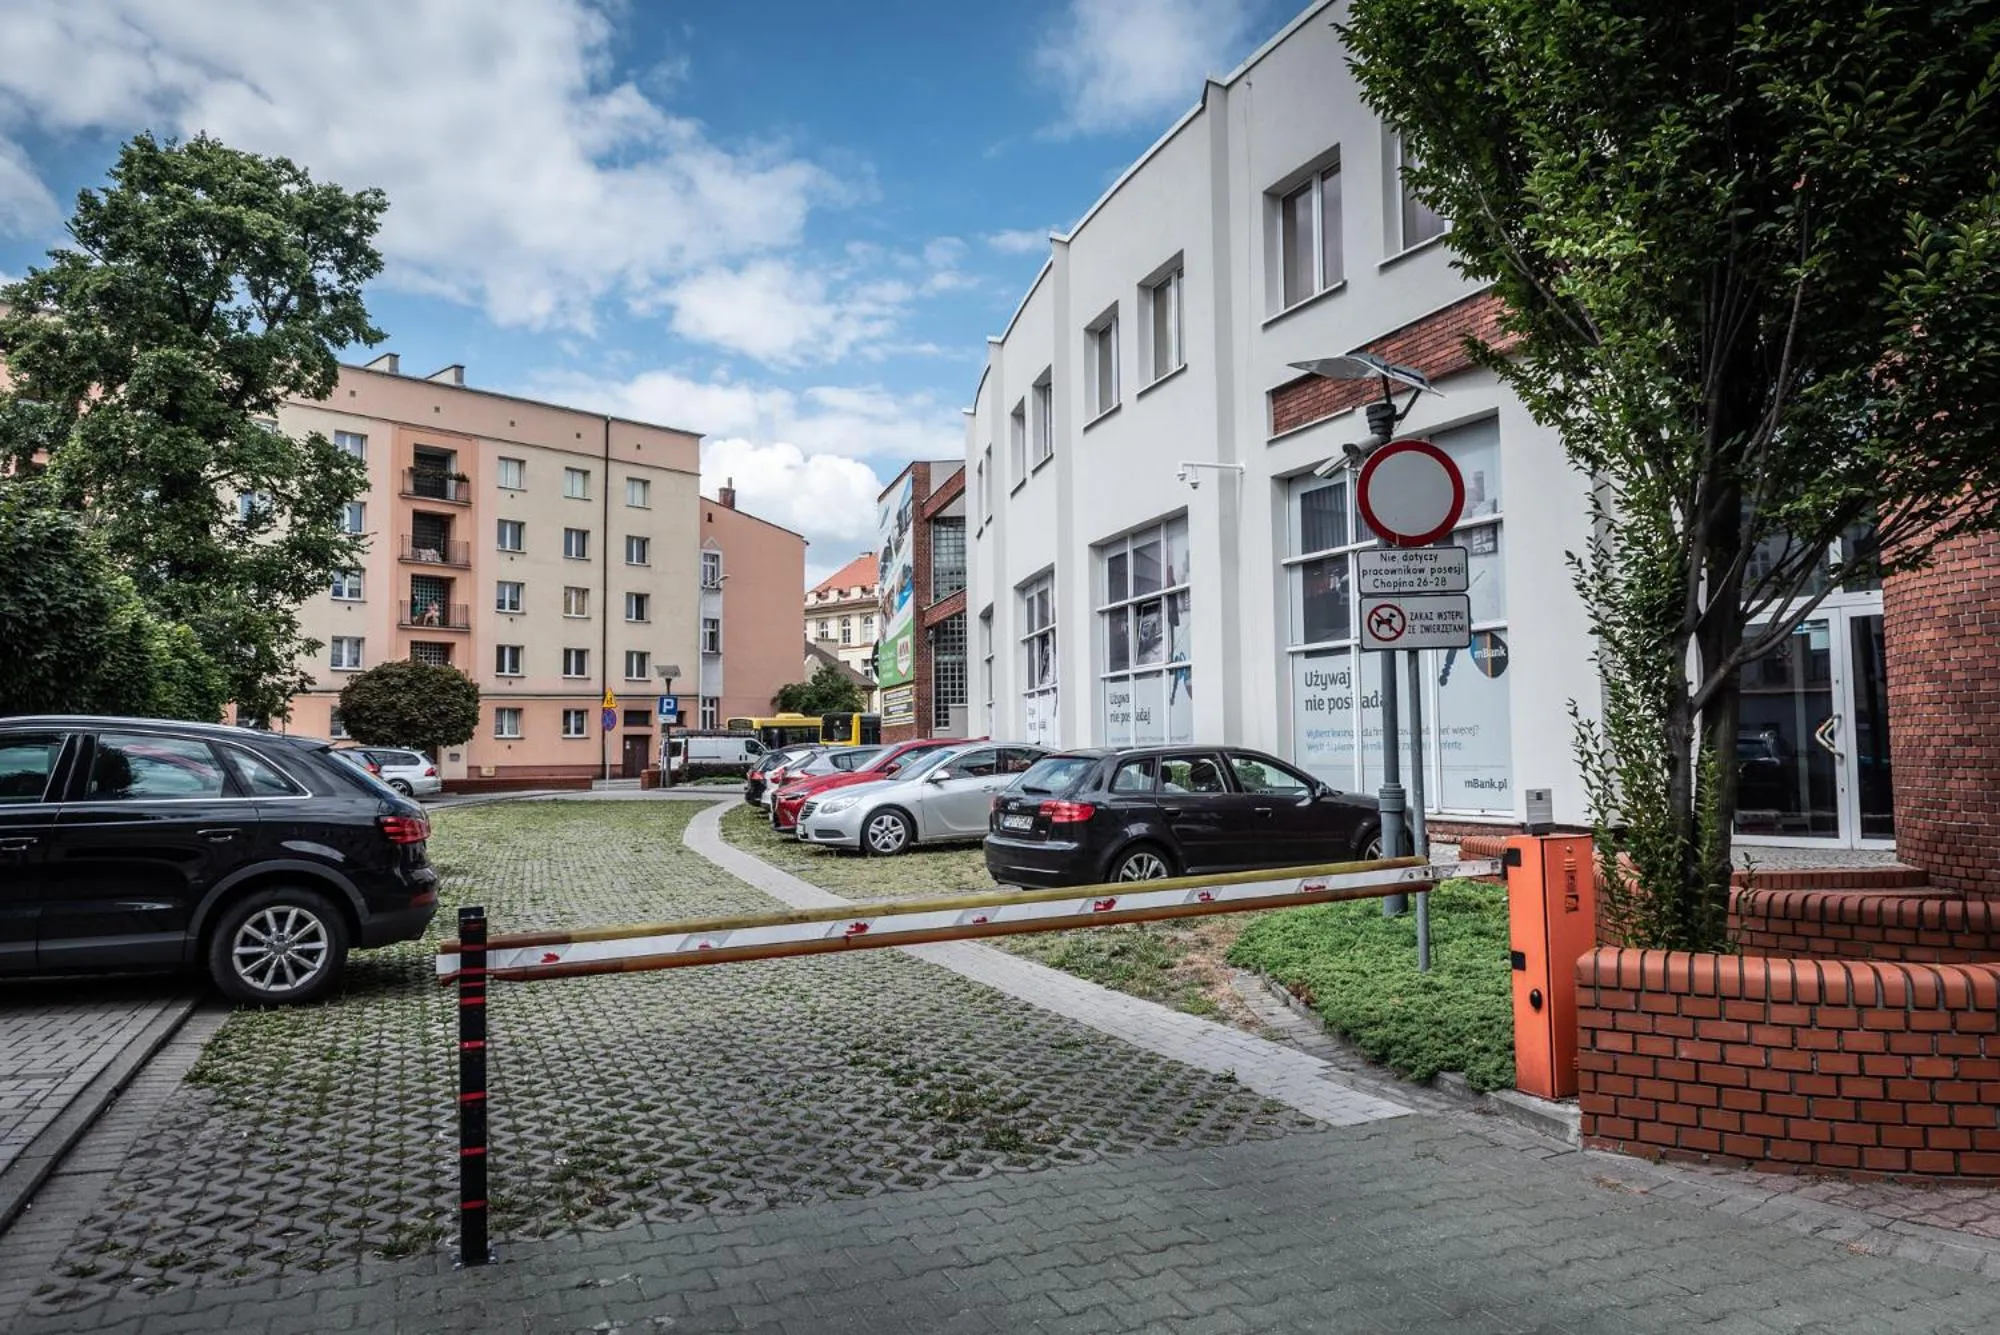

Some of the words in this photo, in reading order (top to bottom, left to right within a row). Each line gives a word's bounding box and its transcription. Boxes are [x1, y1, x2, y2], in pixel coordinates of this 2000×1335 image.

[1380, 552, 1397, 562] Nie
[1402, 552, 1438, 564] dotyczy
[1430, 563, 1465, 576] posesji
[1373, 578, 1414, 590] Chopina
[1416, 576, 1447, 587] 26-28
[1410, 611, 1434, 621] ZAKAZ
[1408, 624, 1416, 634] ZE
[1474, 646, 1507, 659] mBank
[663, 699, 674, 713] P
[1304, 694, 1325, 712] nie
[1464, 779, 1508, 792] mBank.pl
